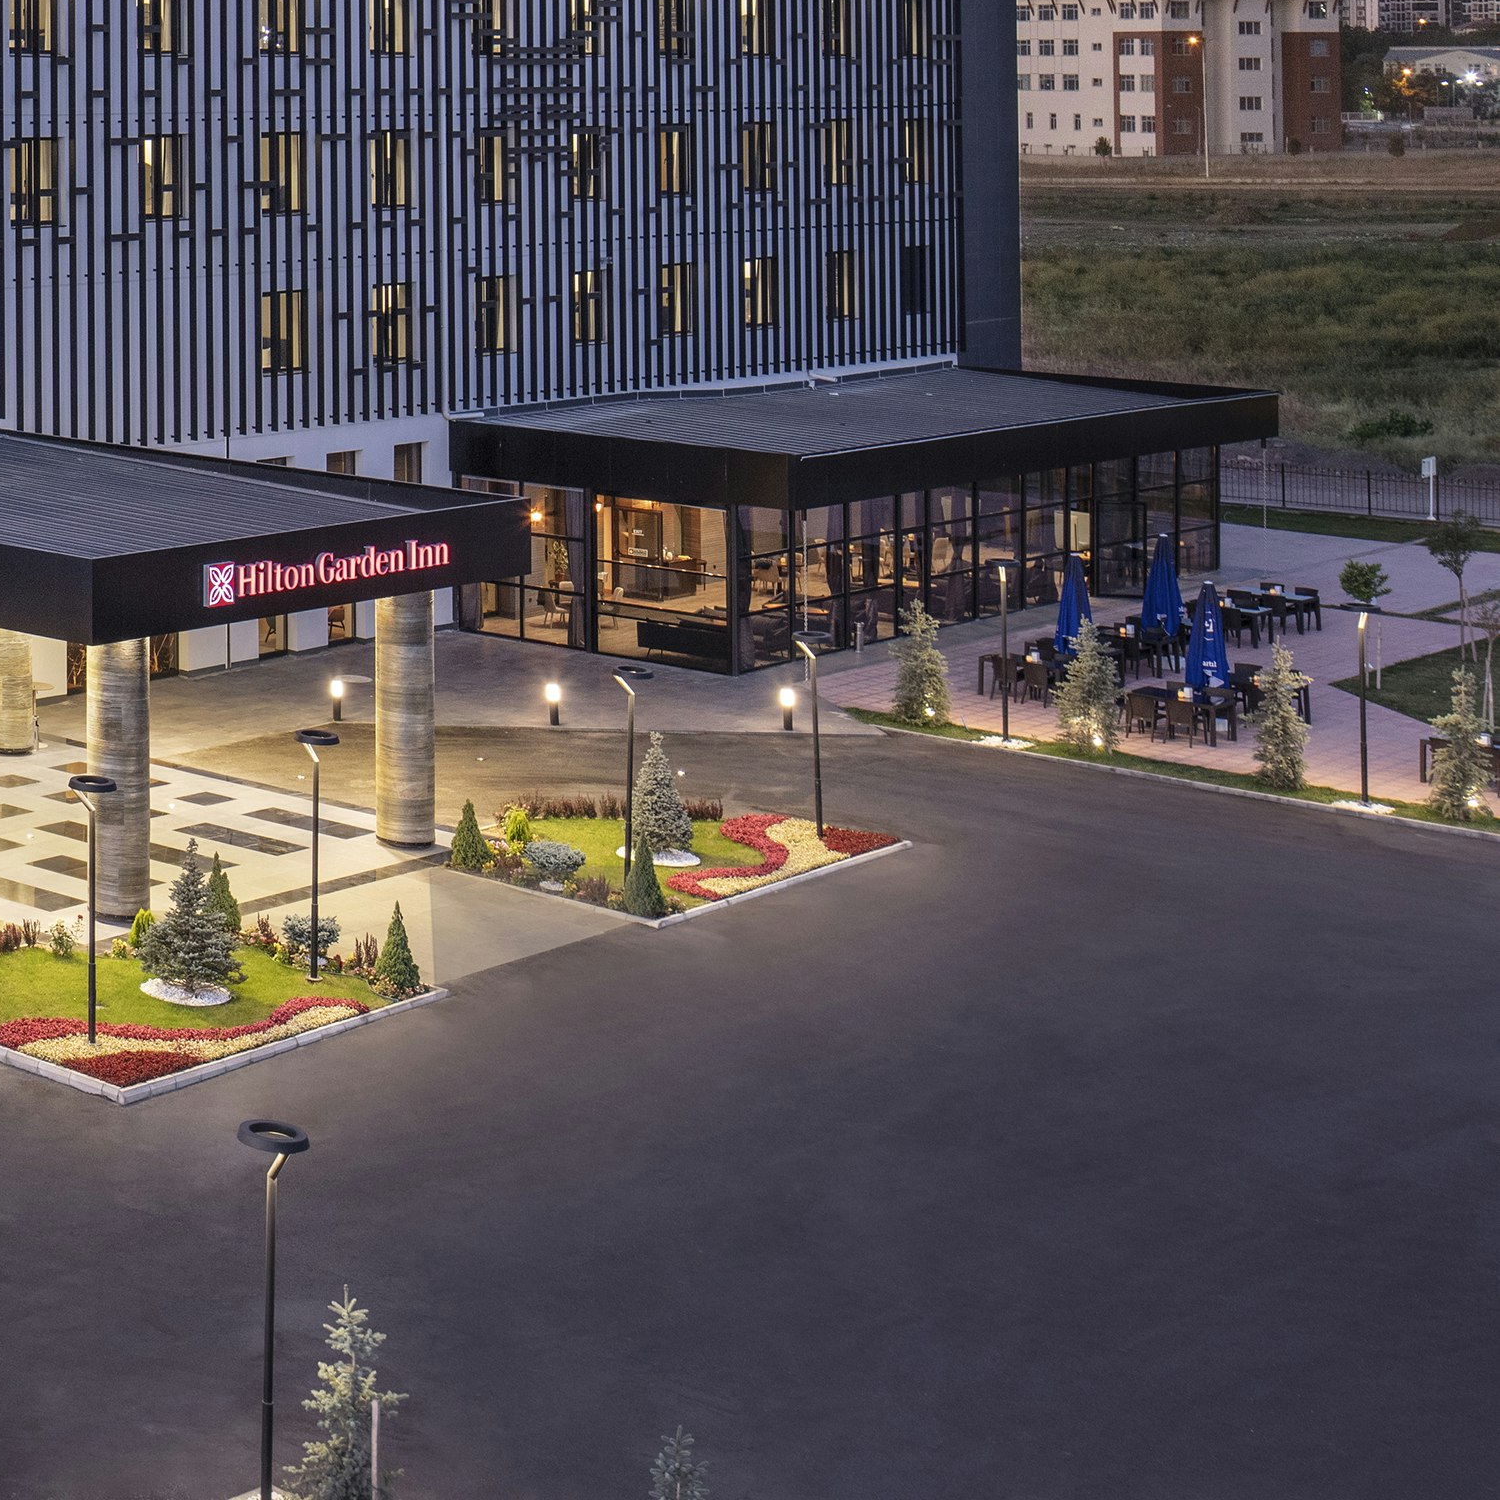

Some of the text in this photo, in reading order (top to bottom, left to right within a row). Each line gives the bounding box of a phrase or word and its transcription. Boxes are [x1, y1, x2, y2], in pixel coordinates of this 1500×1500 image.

[237, 539, 450, 597] Hilton Garden Inn
